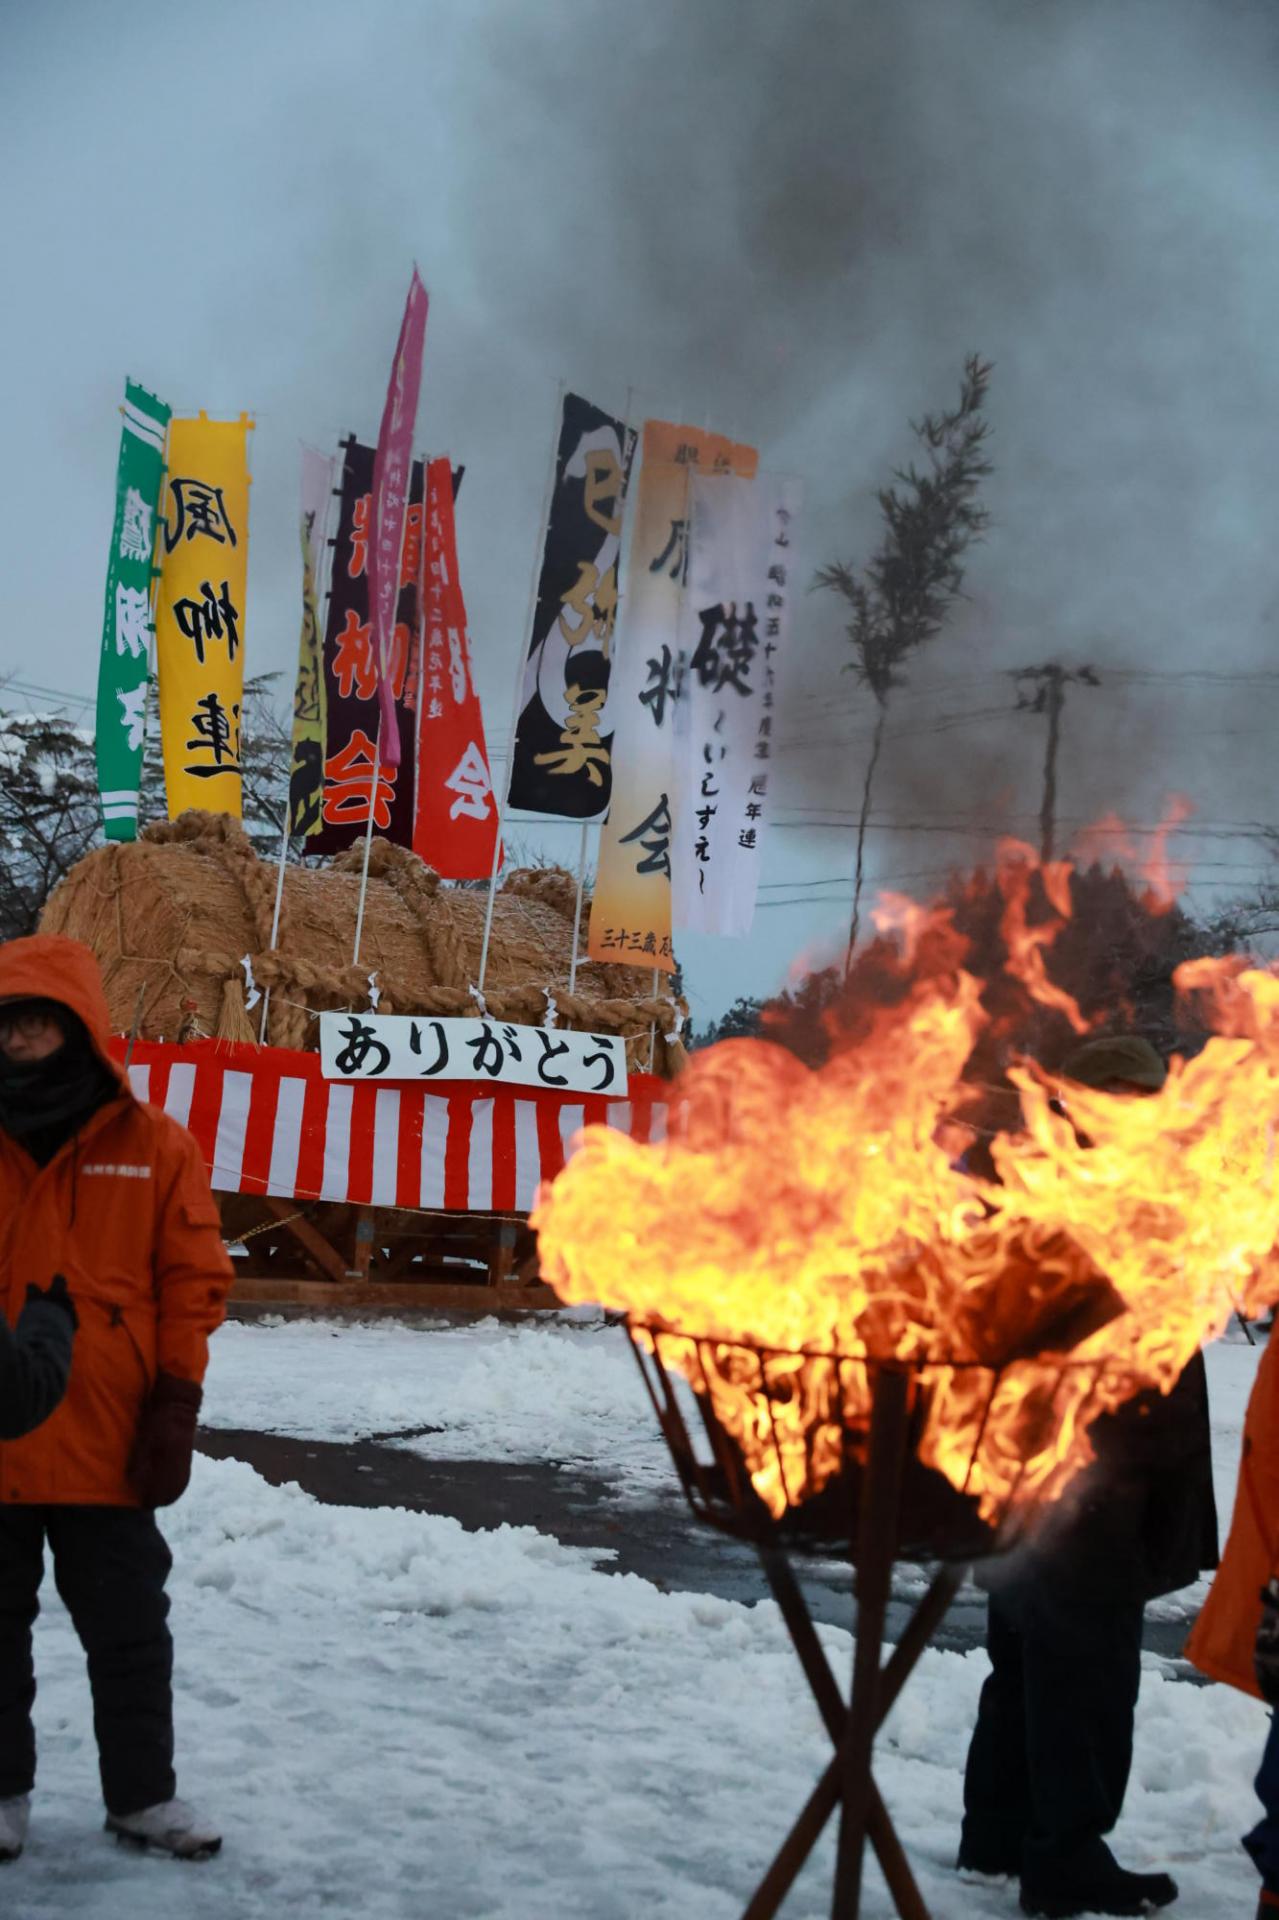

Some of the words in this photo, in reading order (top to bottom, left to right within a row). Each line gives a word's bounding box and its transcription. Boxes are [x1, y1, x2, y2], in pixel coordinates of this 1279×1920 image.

[690, 601, 759, 698] 礎
[335, 1017, 614, 1090] ありがとう
